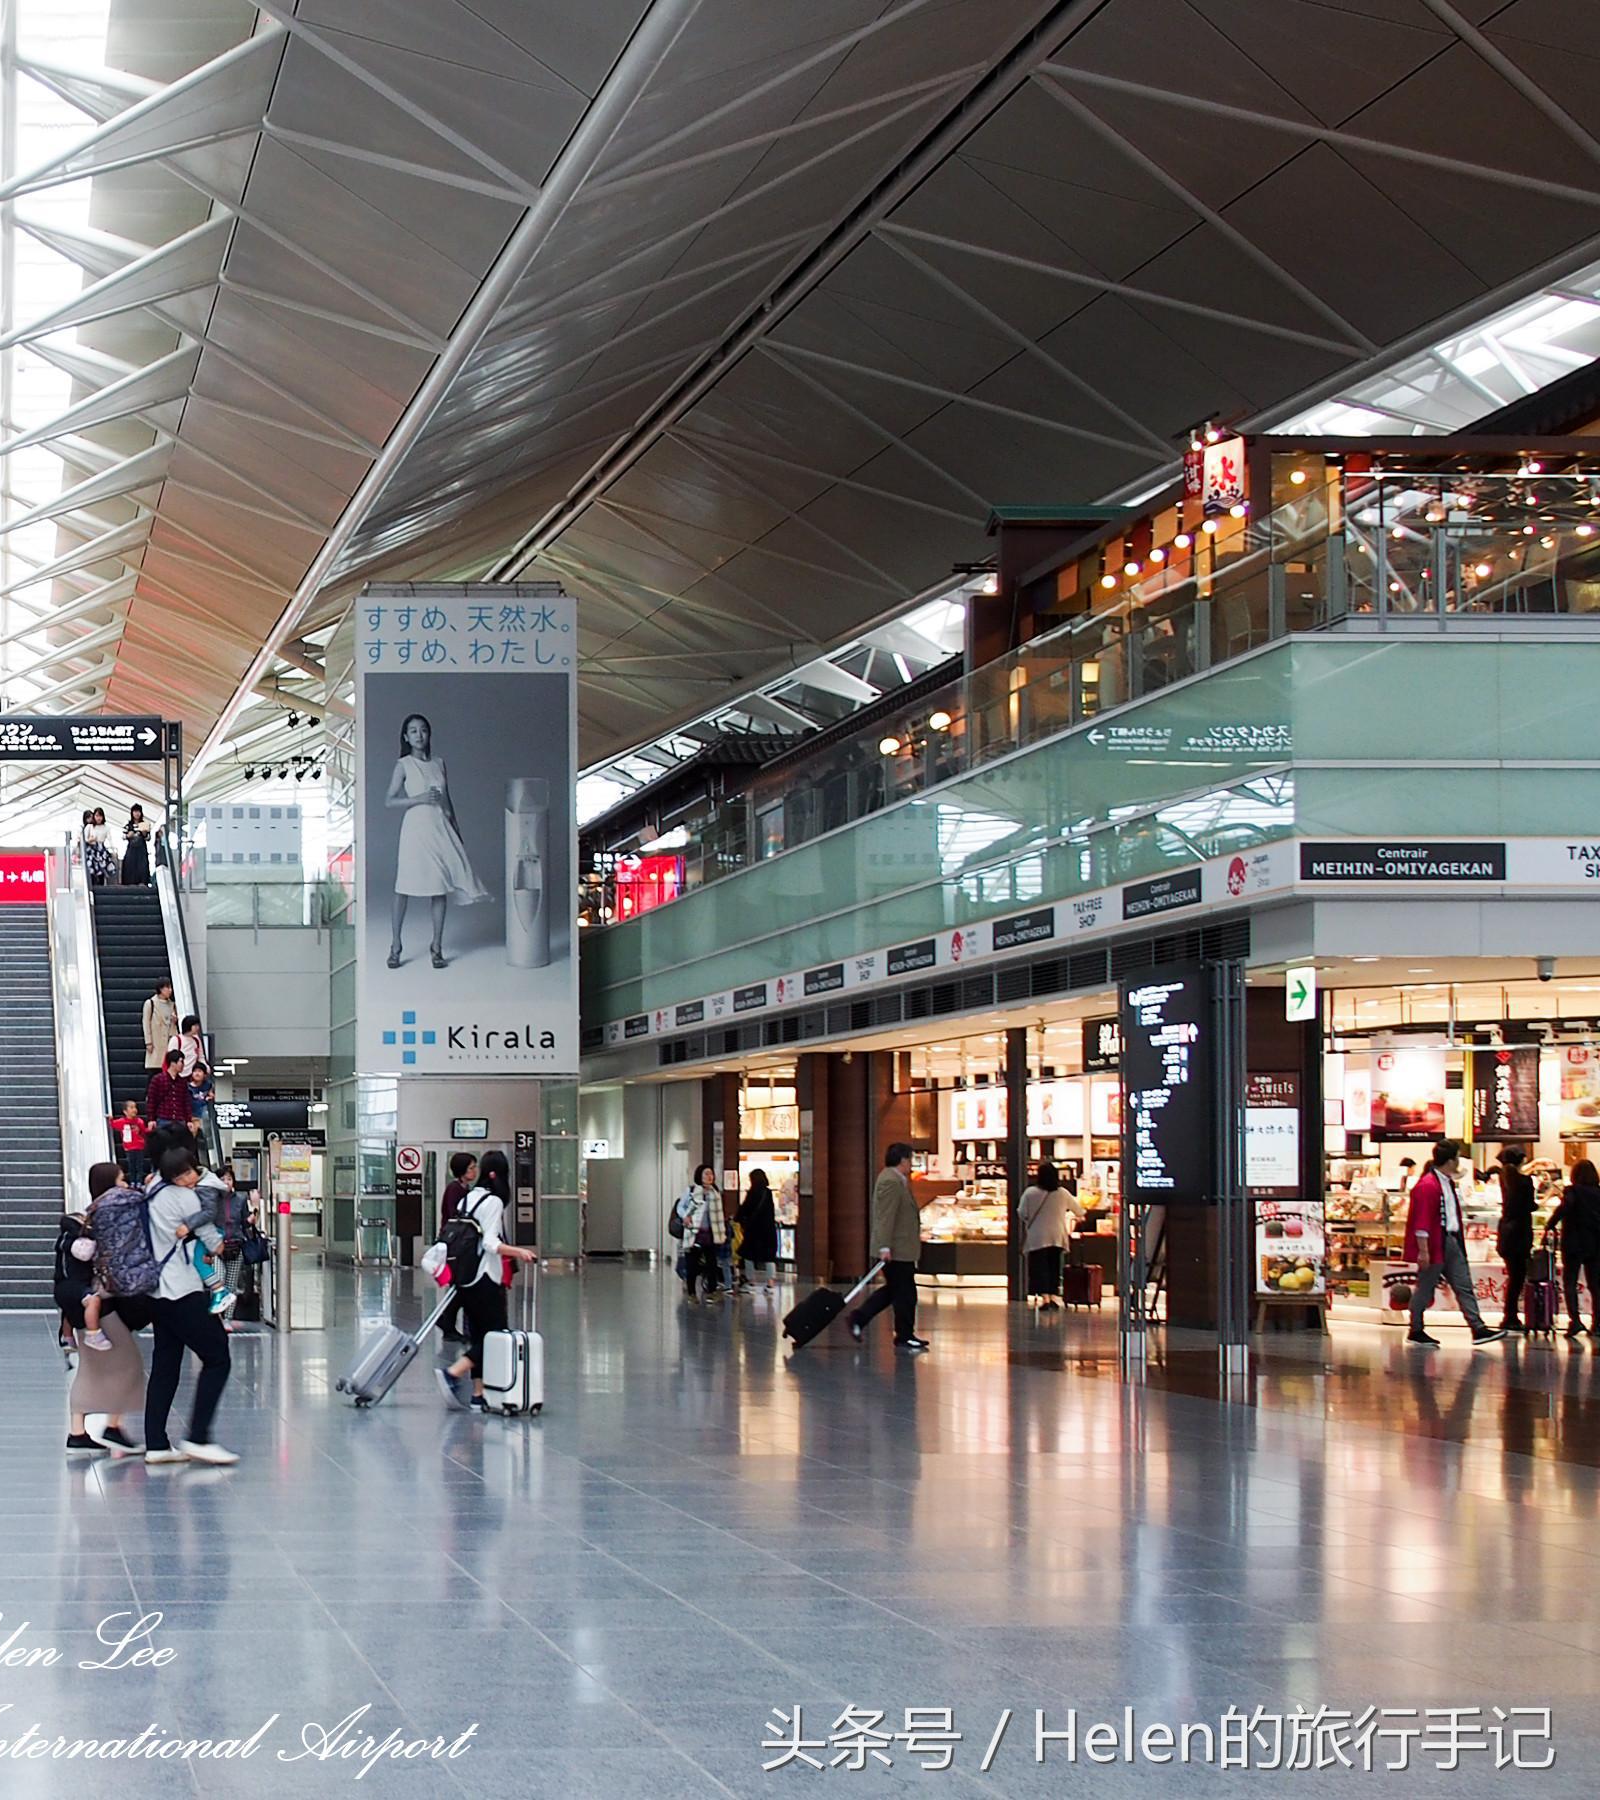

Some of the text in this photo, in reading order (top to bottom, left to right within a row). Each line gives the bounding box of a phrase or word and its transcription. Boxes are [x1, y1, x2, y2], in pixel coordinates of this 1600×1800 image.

[364, 605, 570, 633] すすめ、天然水。
[364, 639, 570, 666] すすめ、わたし。
[1377, 848, 1429, 859] Centrair
[1311, 862, 1494, 876] MEIHIN-OMIYAGEKAN
[1079, 914, 1096, 928] SHOP
[448, 1024, 556, 1049] Kirala
[517, 1133, 534, 1148] 3F
